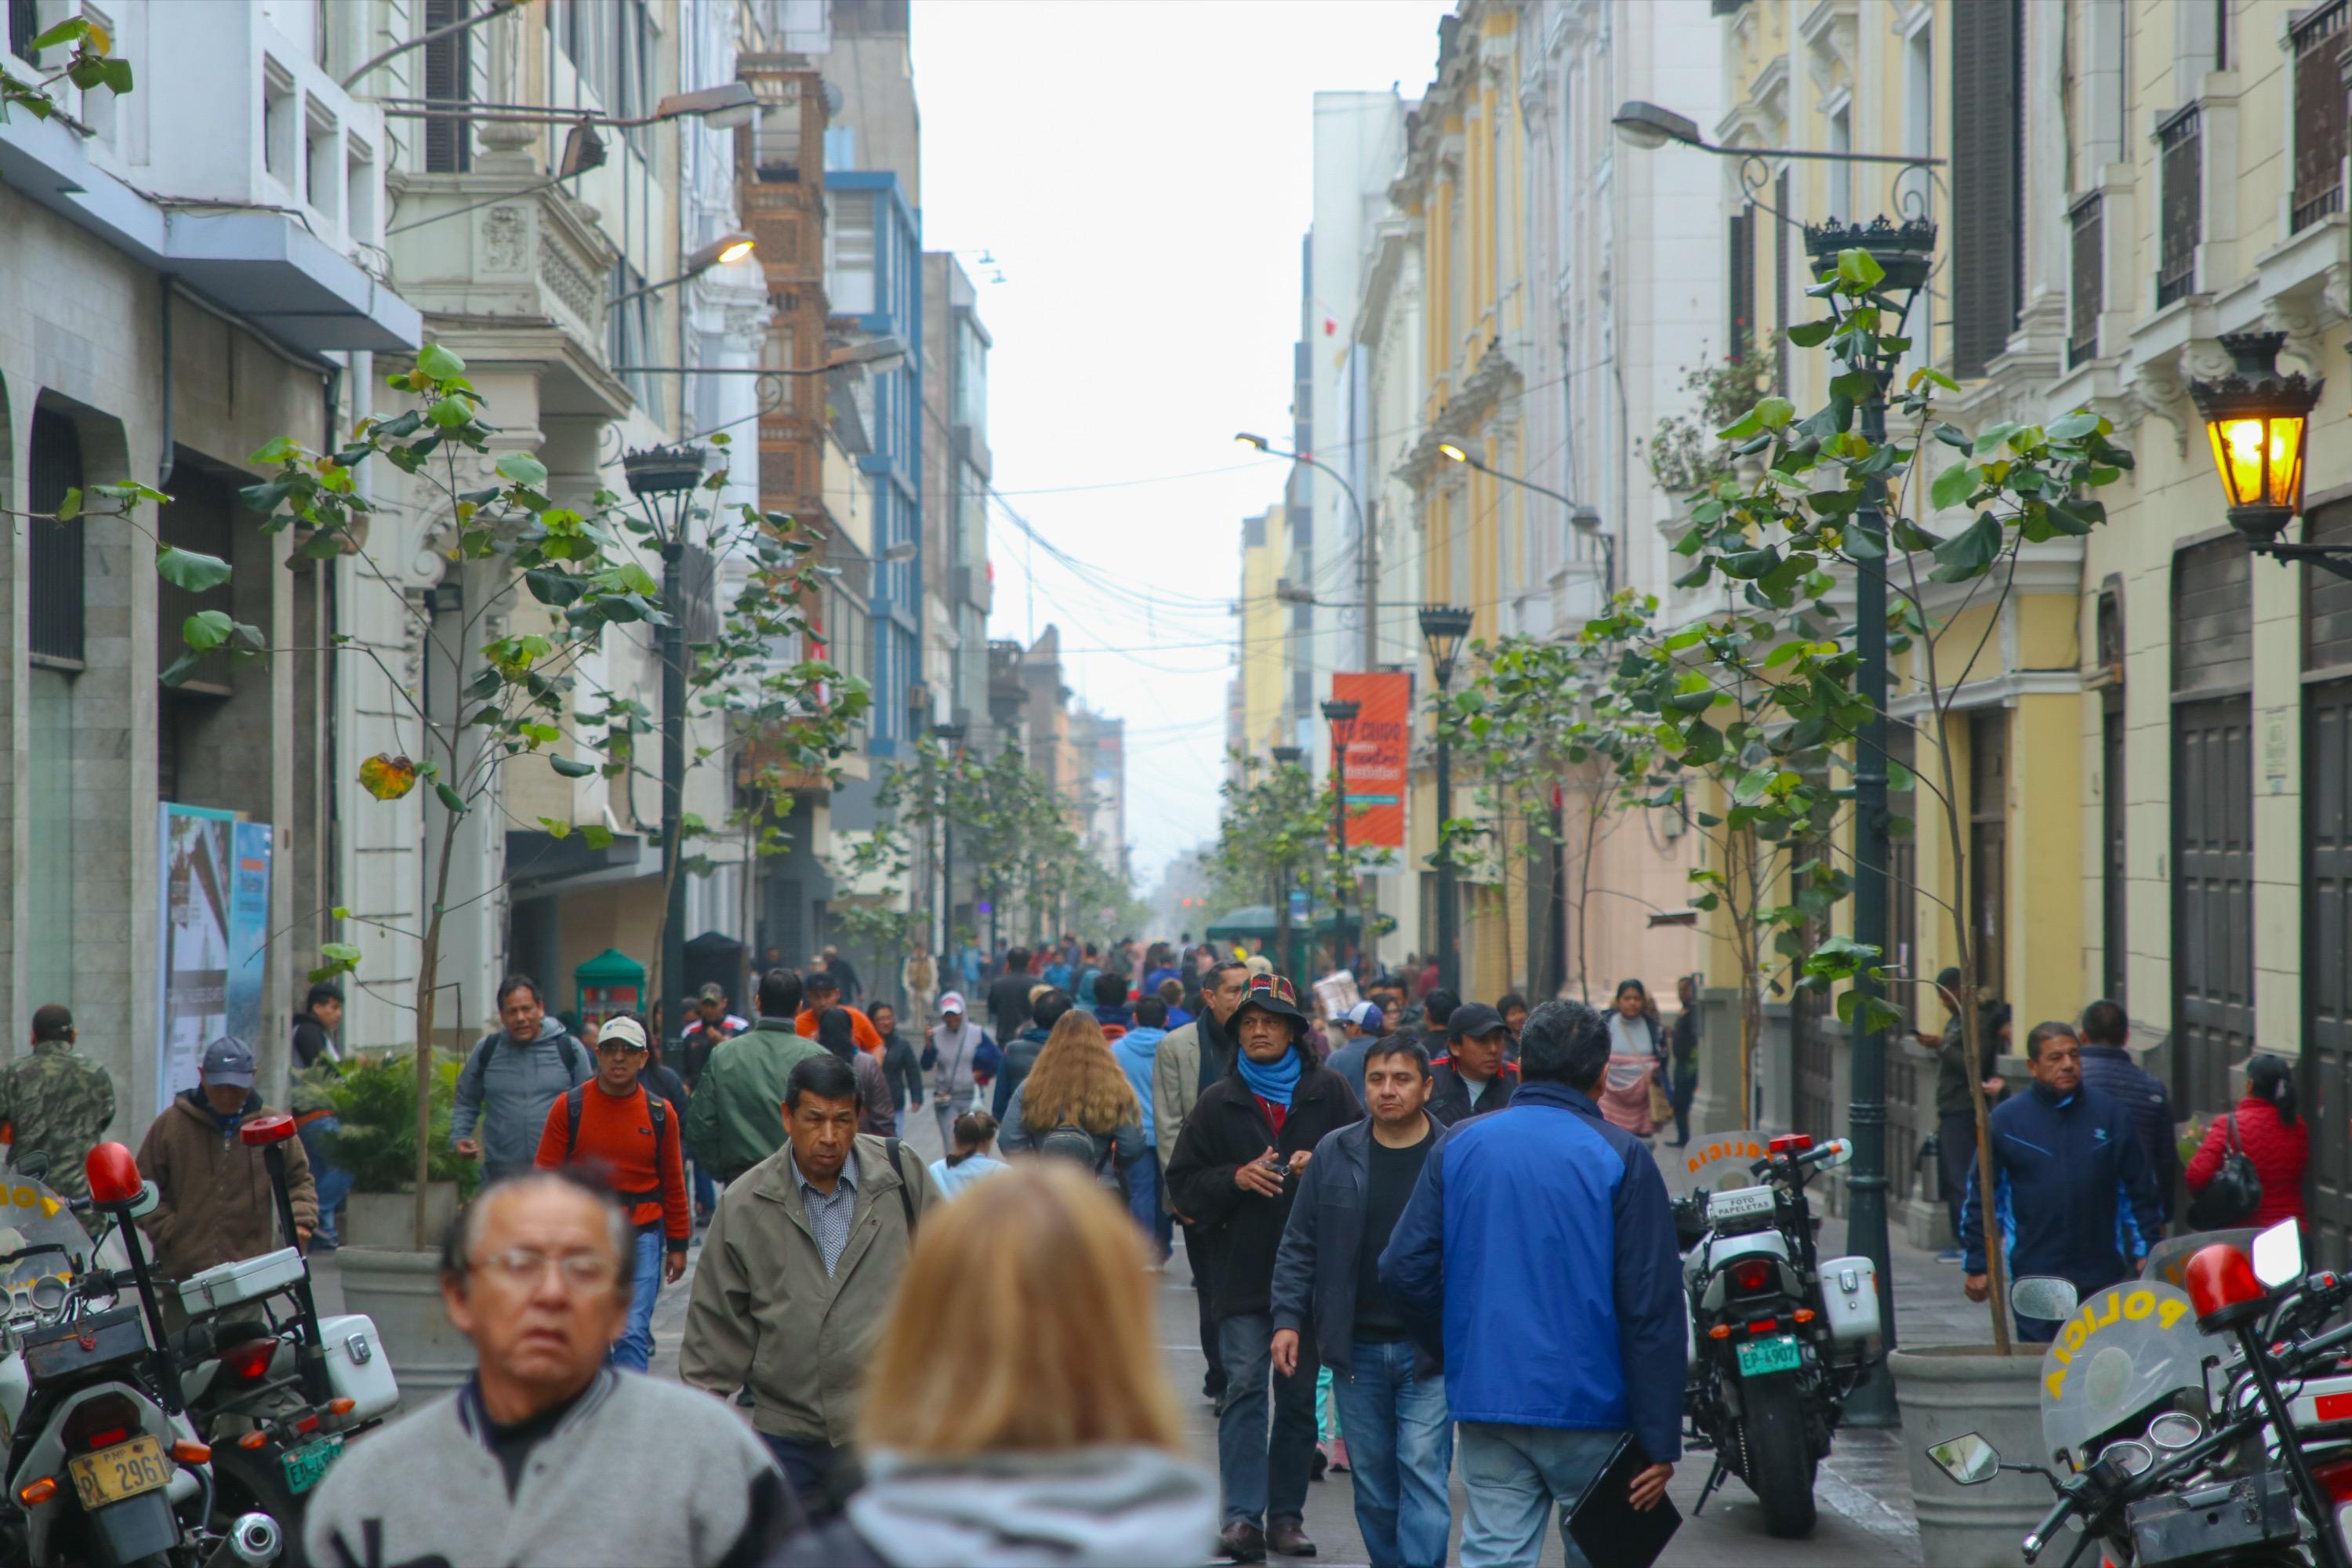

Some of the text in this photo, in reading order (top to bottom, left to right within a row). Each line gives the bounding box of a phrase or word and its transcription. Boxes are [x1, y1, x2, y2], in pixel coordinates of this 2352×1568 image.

[1719, 1201, 1769, 1216] PAPELETAS
[1730, 1196, 1755, 1207] FOTO
[115, 1453, 169, 1491] 2961
